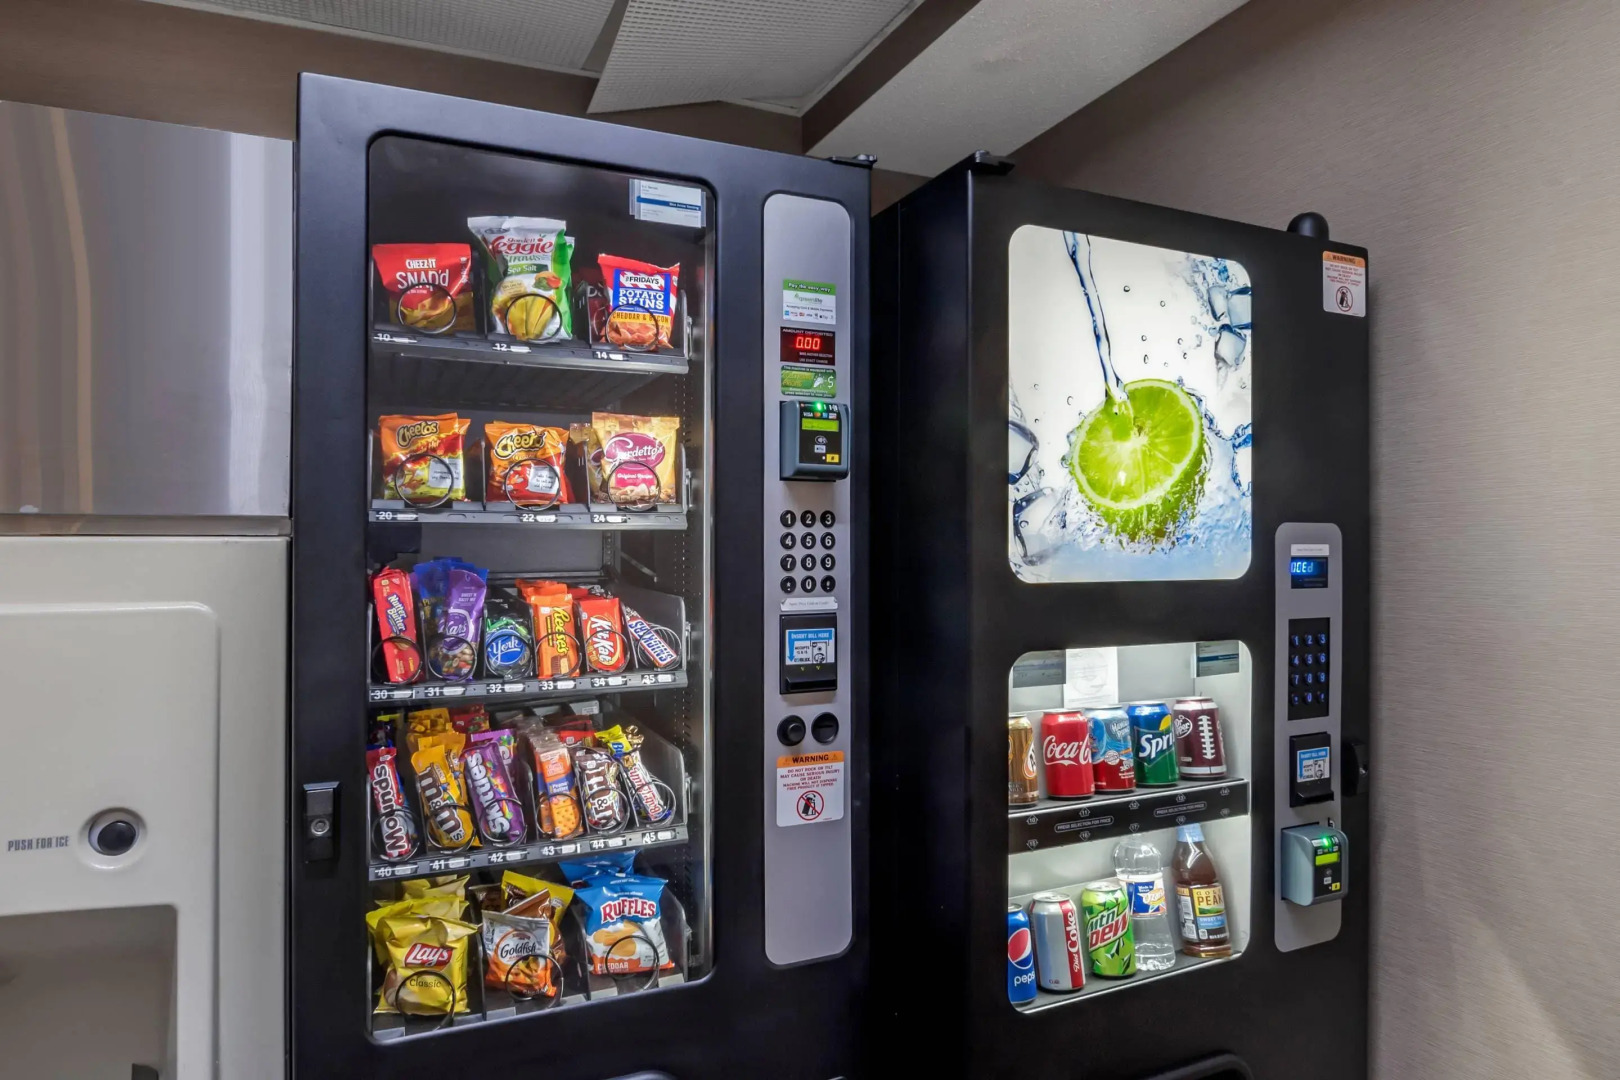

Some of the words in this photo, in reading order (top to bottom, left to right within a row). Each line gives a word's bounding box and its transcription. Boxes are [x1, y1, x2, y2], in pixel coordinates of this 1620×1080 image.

[619, 289, 664, 300] POTATO
[619, 297, 664, 310] SKINS
[612, 312, 640, 320] CHEDDAR
[377, 333, 391, 342] 10
[494, 343, 507, 351] 12
[596, 351, 607, 359] 14
[397, 421, 438, 447] Cheetos
[378, 511, 393, 520] 20
[522, 513, 535, 522] 22
[593, 514, 606, 523] 24
[785, 513, 792, 525] 1
[805, 513, 812, 524] 2
[825, 513, 832, 525] 3
[785, 535, 792, 546] 4
[805, 535, 812, 547] 5
[825, 535, 832, 547] 6
[786, 557, 793, 569] 7
[805, 557, 812, 568] 8
[825, 557, 832, 568] 9
[805, 579, 812, 590] 0
[387, 594, 407, 621] Nutter
[387, 607, 406, 631] Butter
[628, 620, 674, 662] SNICKERS
[1294, 635, 1299, 646] 1
[1307, 635, 1313, 645] 2
[1320, 633, 1326, 644] 3
[492, 636, 521, 662] York
[1293, 655, 1299, 665] 4
[1307, 654, 1313, 664] 5
[1320, 653, 1326, 663] 6
[593, 677, 606, 687] 34
[1295, 674, 1299, 685] 7
[489, 683, 502, 693] 32
[541, 681, 554, 690] 33
[374, 690, 388, 700] 30
[427, 687, 440, 697] 31
[1043, 733, 1092, 766] Coca-C
[1138, 732, 1175, 759] Spri
[792, 754, 829, 764] WARNING
[373, 764, 408, 852] Mounds
[7, 839, 33, 852] PUSH
[35, 836, 53, 849] FOR
[55, 835, 69, 848] ICE
[592, 840, 604, 849] 44
[542, 845, 555, 856] 43
[490, 852, 503, 863] 42
[432, 859, 445, 870] 41
[378, 866, 392, 877] 40
[601, 897, 656, 924] RUFFLES
[1065, 911, 1079, 953] Coke
[500, 941, 537, 959] Goldfish
[409, 974, 442, 988] Classic
[1014, 970, 1036, 987] peps
